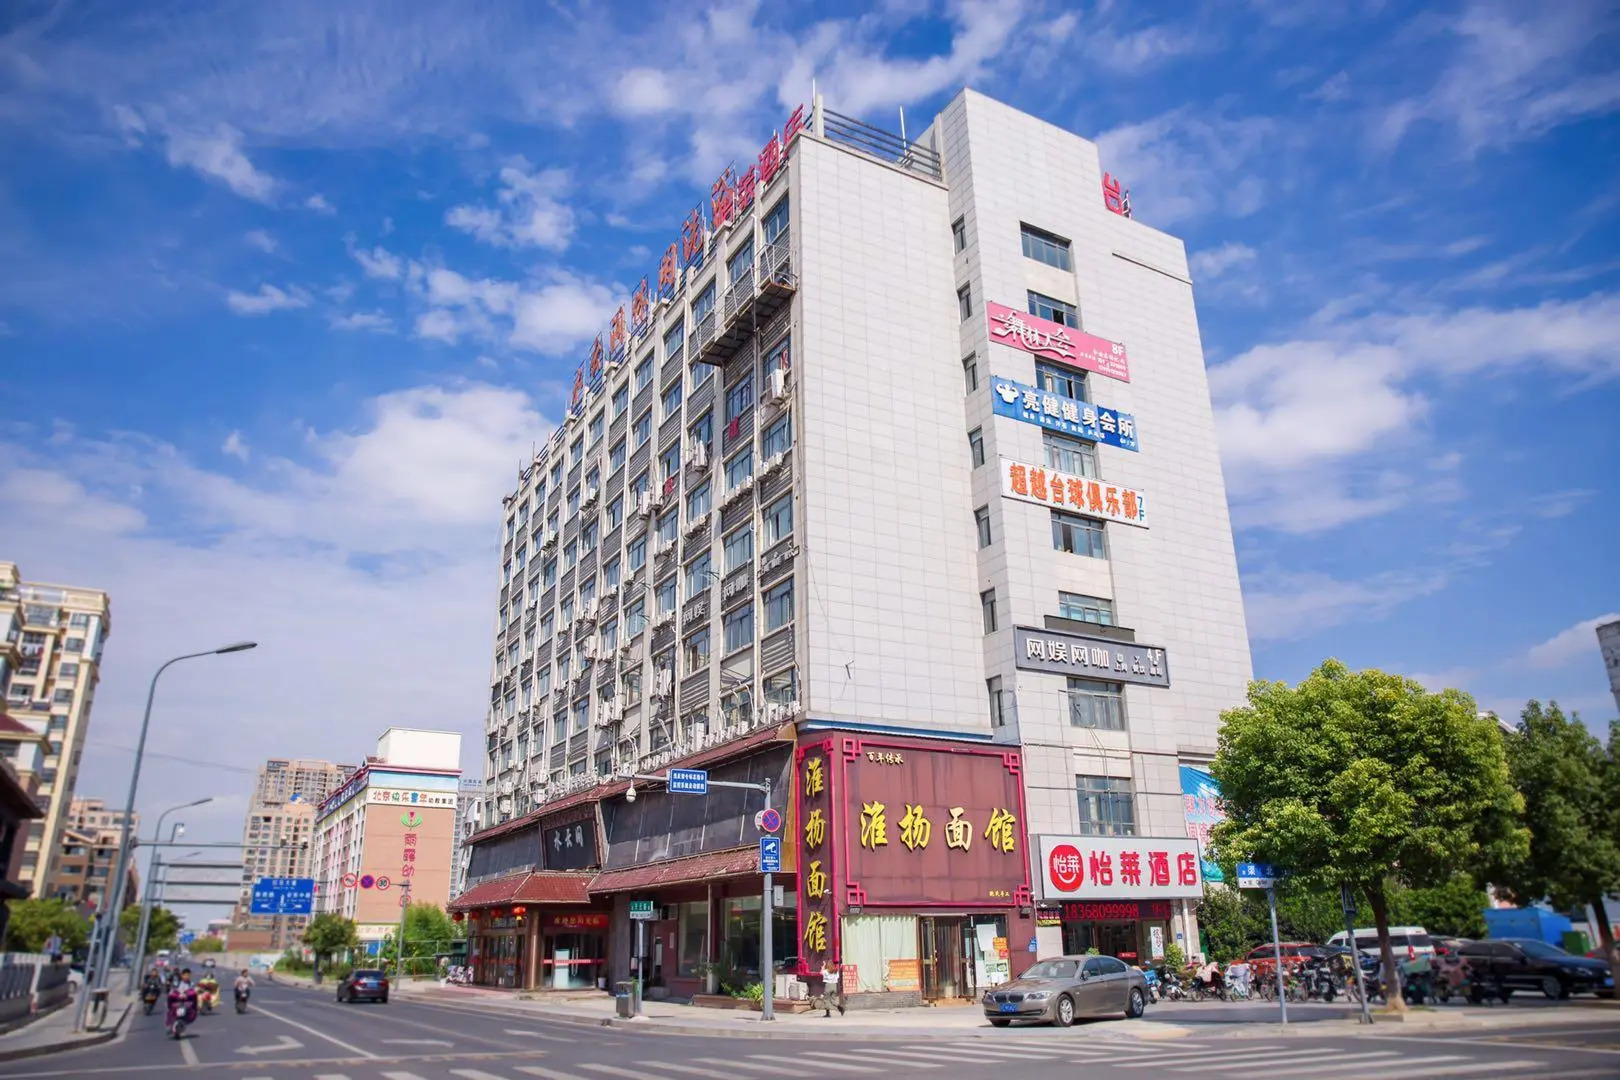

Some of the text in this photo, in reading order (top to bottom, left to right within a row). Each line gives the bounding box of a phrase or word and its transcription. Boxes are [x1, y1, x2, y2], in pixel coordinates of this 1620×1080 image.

[1023, 389, 1134, 440] 亮健健身会所
[1010, 462, 1139, 520] 超越台球俱乐部
[1026, 638, 1110, 669] 网娱网咖
[860, 800, 1016, 853] 淮扬面馆
[804, 757, 829, 952] 淮扬面馆
[1053, 854, 1080, 874] 怡莱
[1089, 850, 1198, 886] 怡莱酒店
